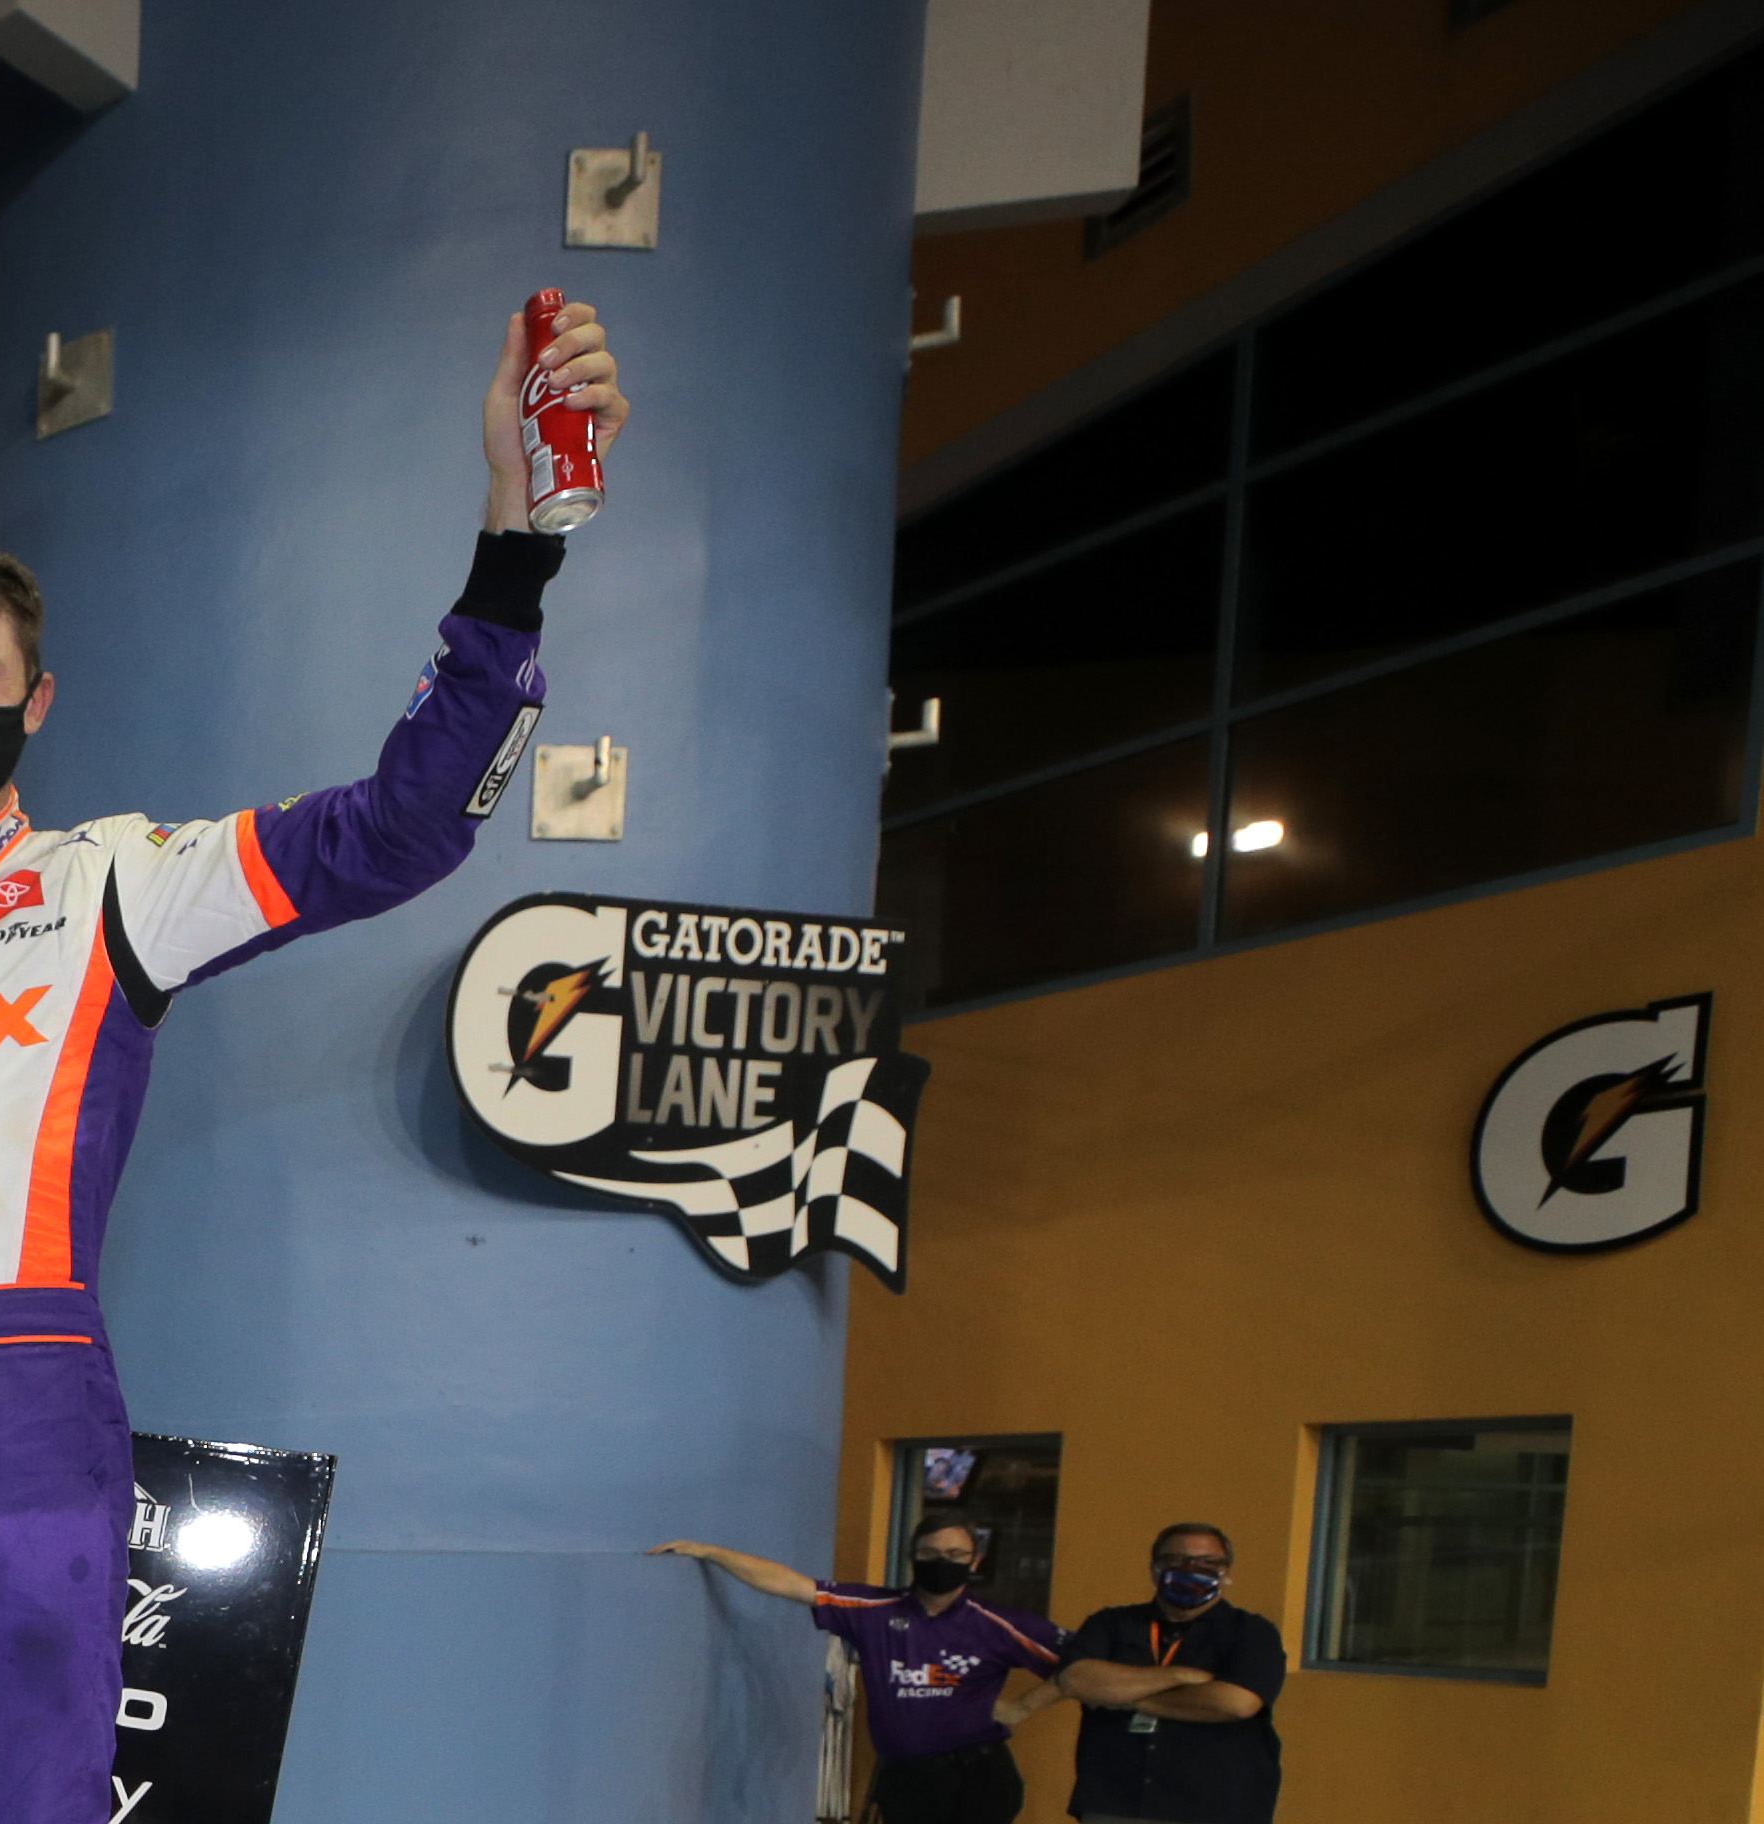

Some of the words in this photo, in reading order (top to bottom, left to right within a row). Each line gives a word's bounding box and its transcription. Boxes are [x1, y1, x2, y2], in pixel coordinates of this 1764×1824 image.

[632, 910, 887, 975] GATORADE
[630, 972, 882, 1057] VICTORY
[626, 1055, 781, 1129] LANE
[891, 1660, 963, 1686] FedEx
[897, 1687, 953, 1698] RACING
